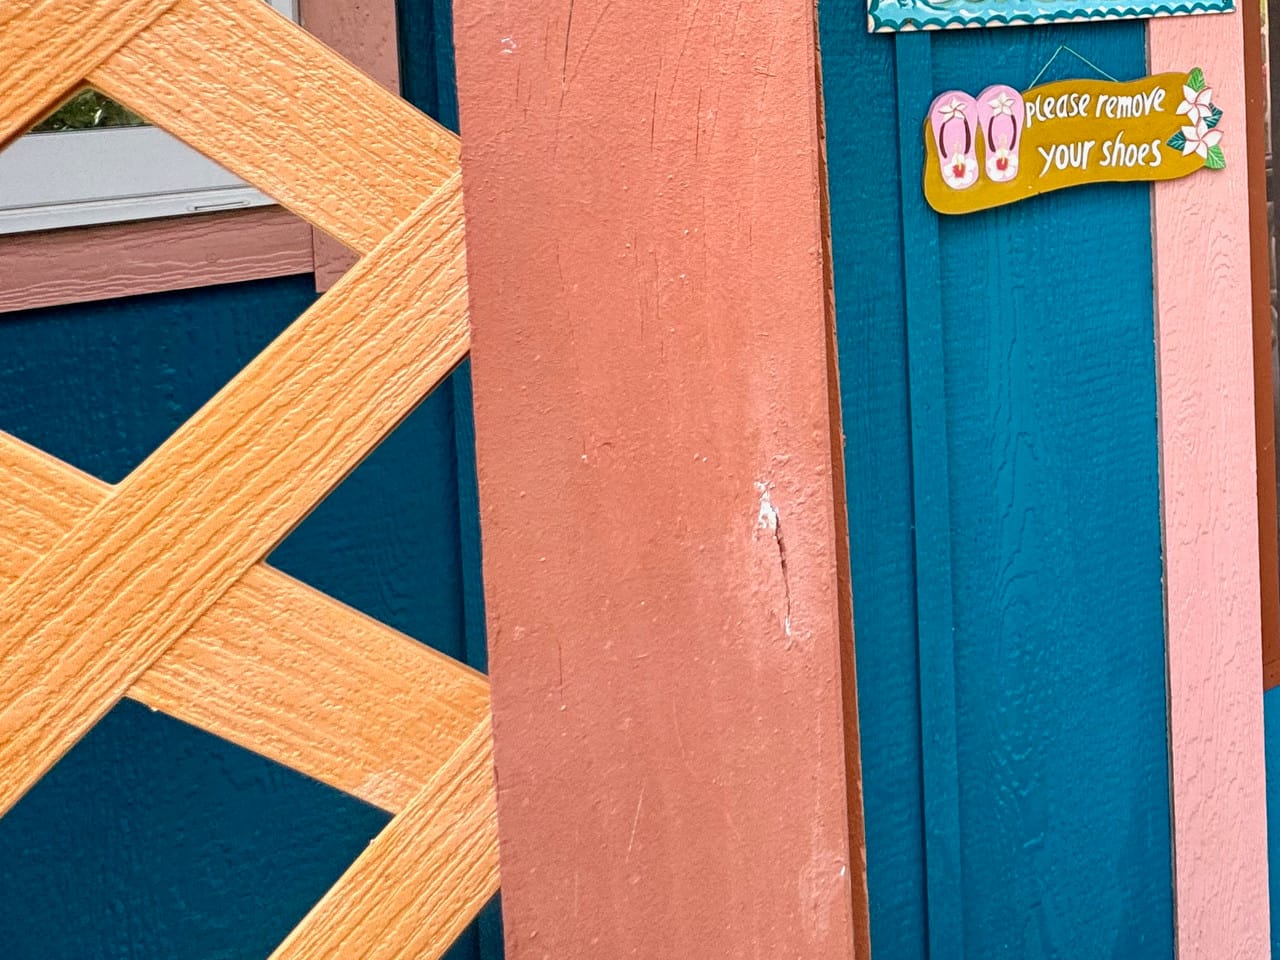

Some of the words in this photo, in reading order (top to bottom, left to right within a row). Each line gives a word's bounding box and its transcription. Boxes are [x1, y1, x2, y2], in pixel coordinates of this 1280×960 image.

[1025, 94, 1089, 128] please
[1096, 86, 1166, 119] remove
[1038, 140, 1095, 178] your
[1099, 131, 1162, 167] shoes
